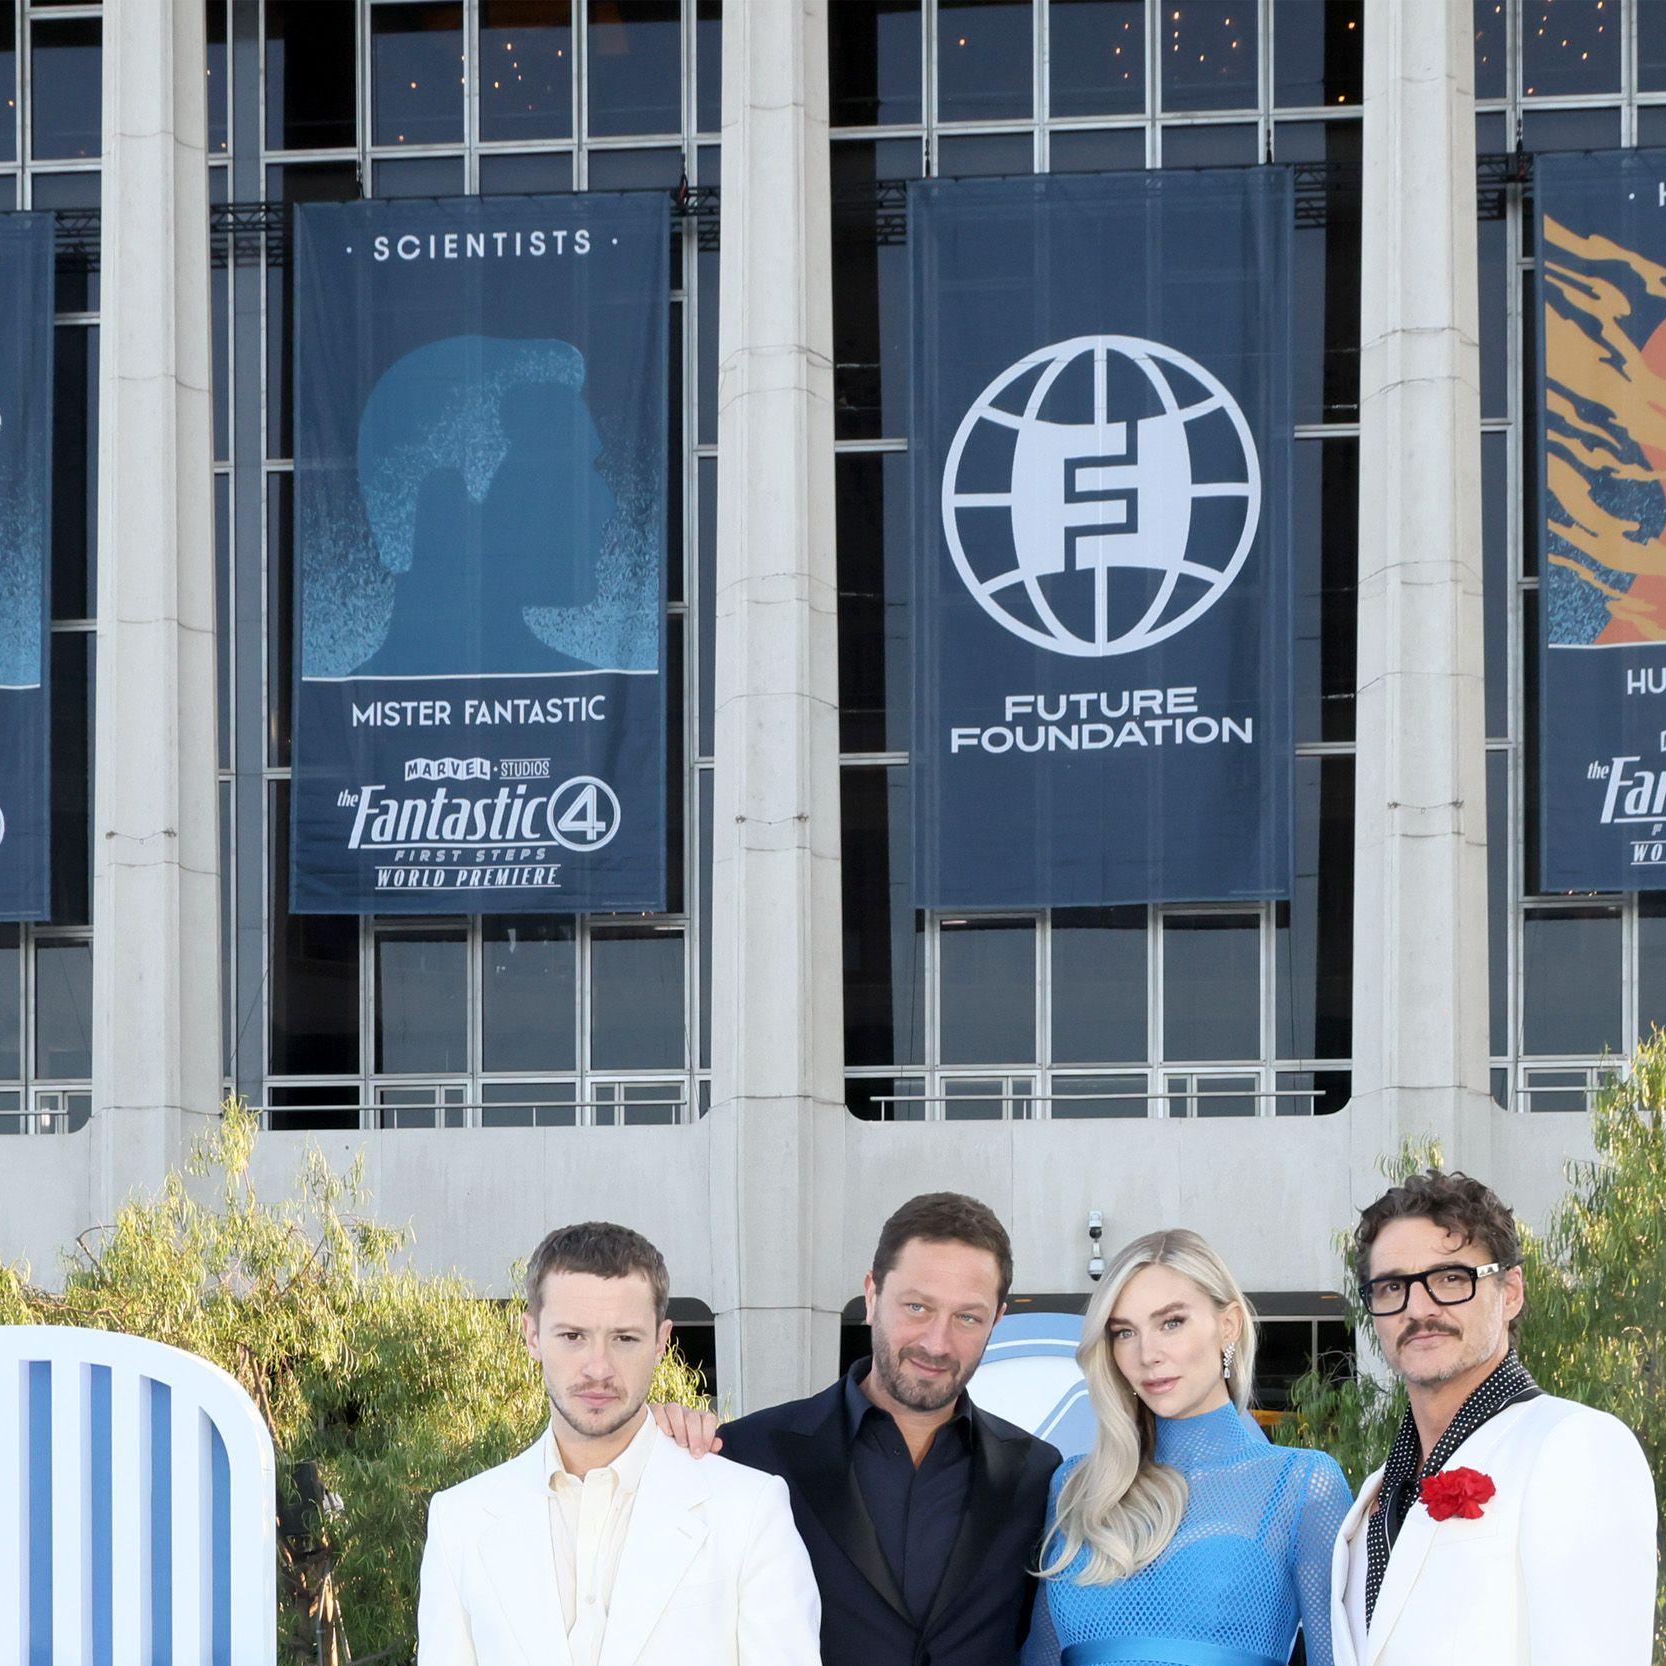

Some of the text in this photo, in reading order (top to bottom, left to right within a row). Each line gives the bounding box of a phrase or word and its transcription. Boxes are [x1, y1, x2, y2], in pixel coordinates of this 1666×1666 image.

[374, 230, 590, 260] SCIENTISTS
[353, 695, 605, 726] MISTER FANTASTIC
[1006, 687, 1198, 723] FUTURE
[951, 716, 1252, 753] FOUNDATION
[405, 757, 549, 781] MARVEL STUDIOS
[1587, 760, 1609, 779] the
[337, 790, 358, 807] the
[348, 784, 547, 849] Fantastic
[394, 848, 546, 861] FIRST STEPS
[377, 867, 558, 887] WORLD PREMIERE
